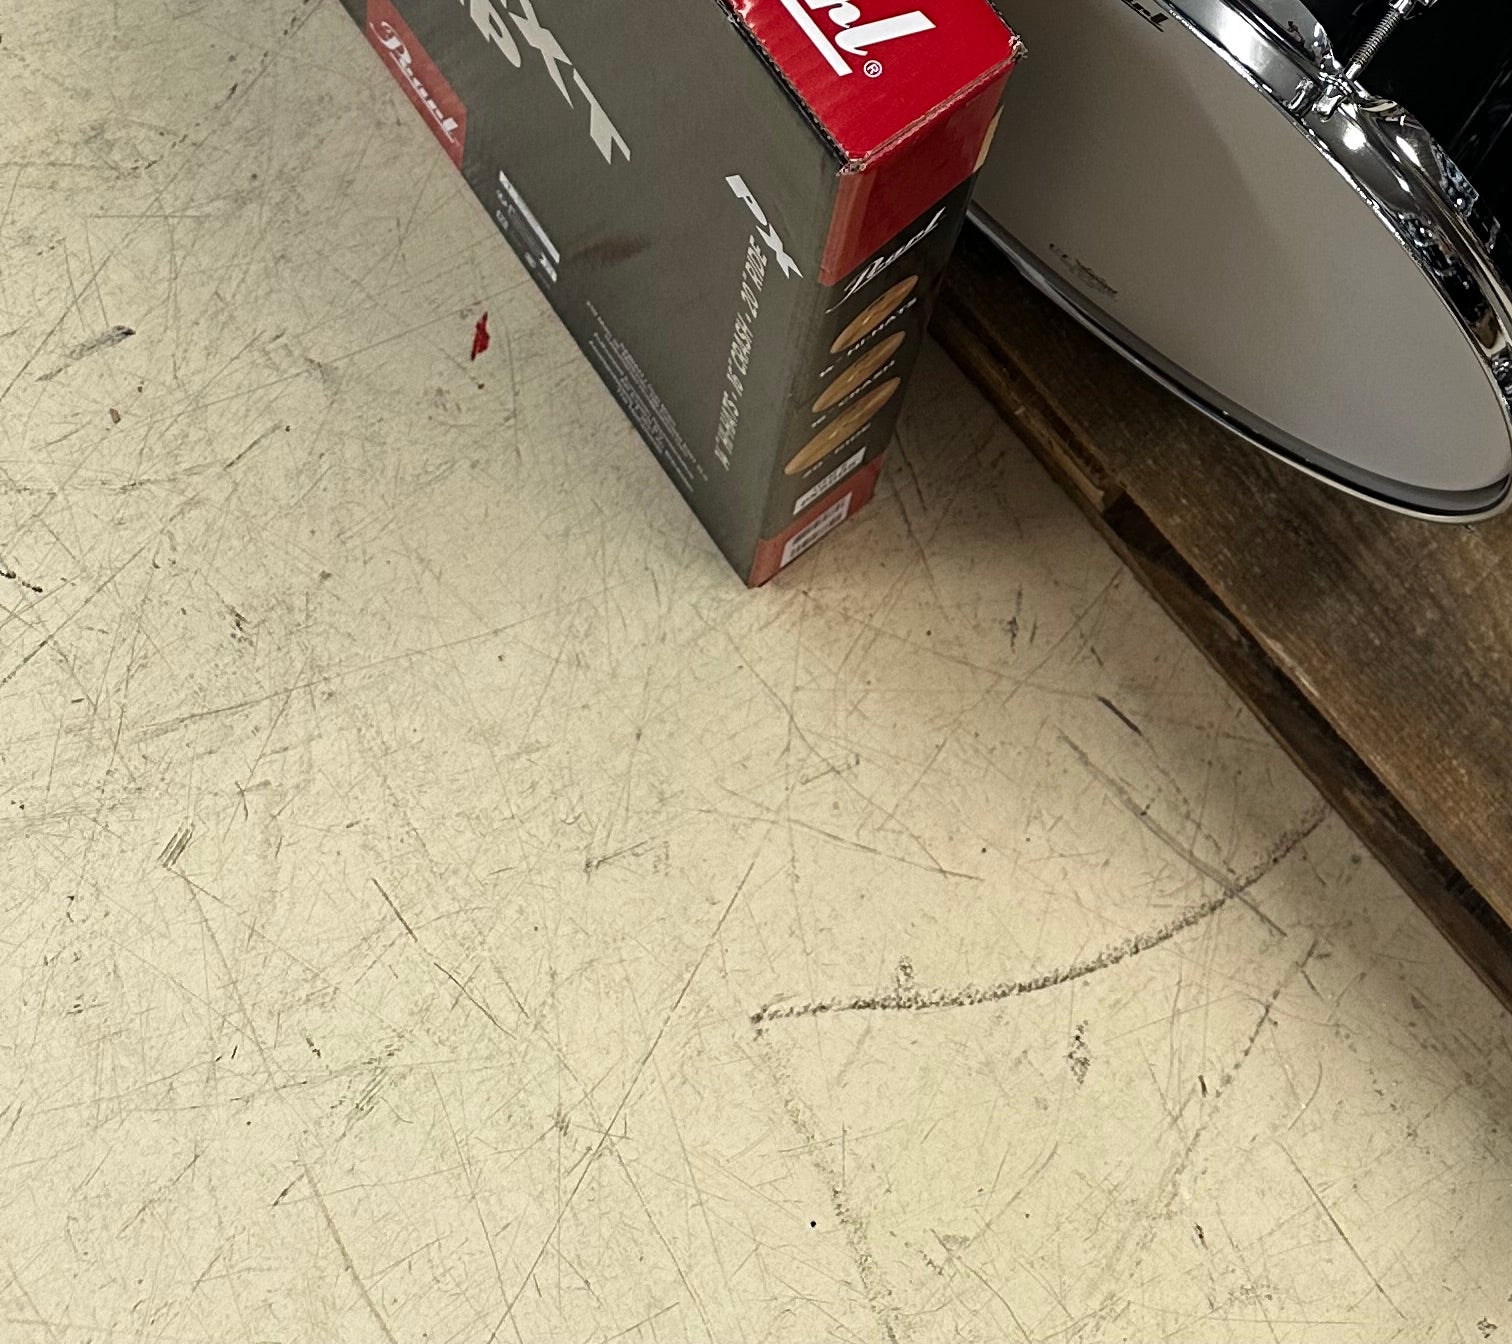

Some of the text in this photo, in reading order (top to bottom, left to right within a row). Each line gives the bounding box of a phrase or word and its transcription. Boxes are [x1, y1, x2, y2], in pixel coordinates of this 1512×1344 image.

[369, 20, 459, 143] Pearl
[725, 174, 803, 279] PX
[745, 234, 768, 293] RIDE
[825, 206, 946, 314] Pearl
